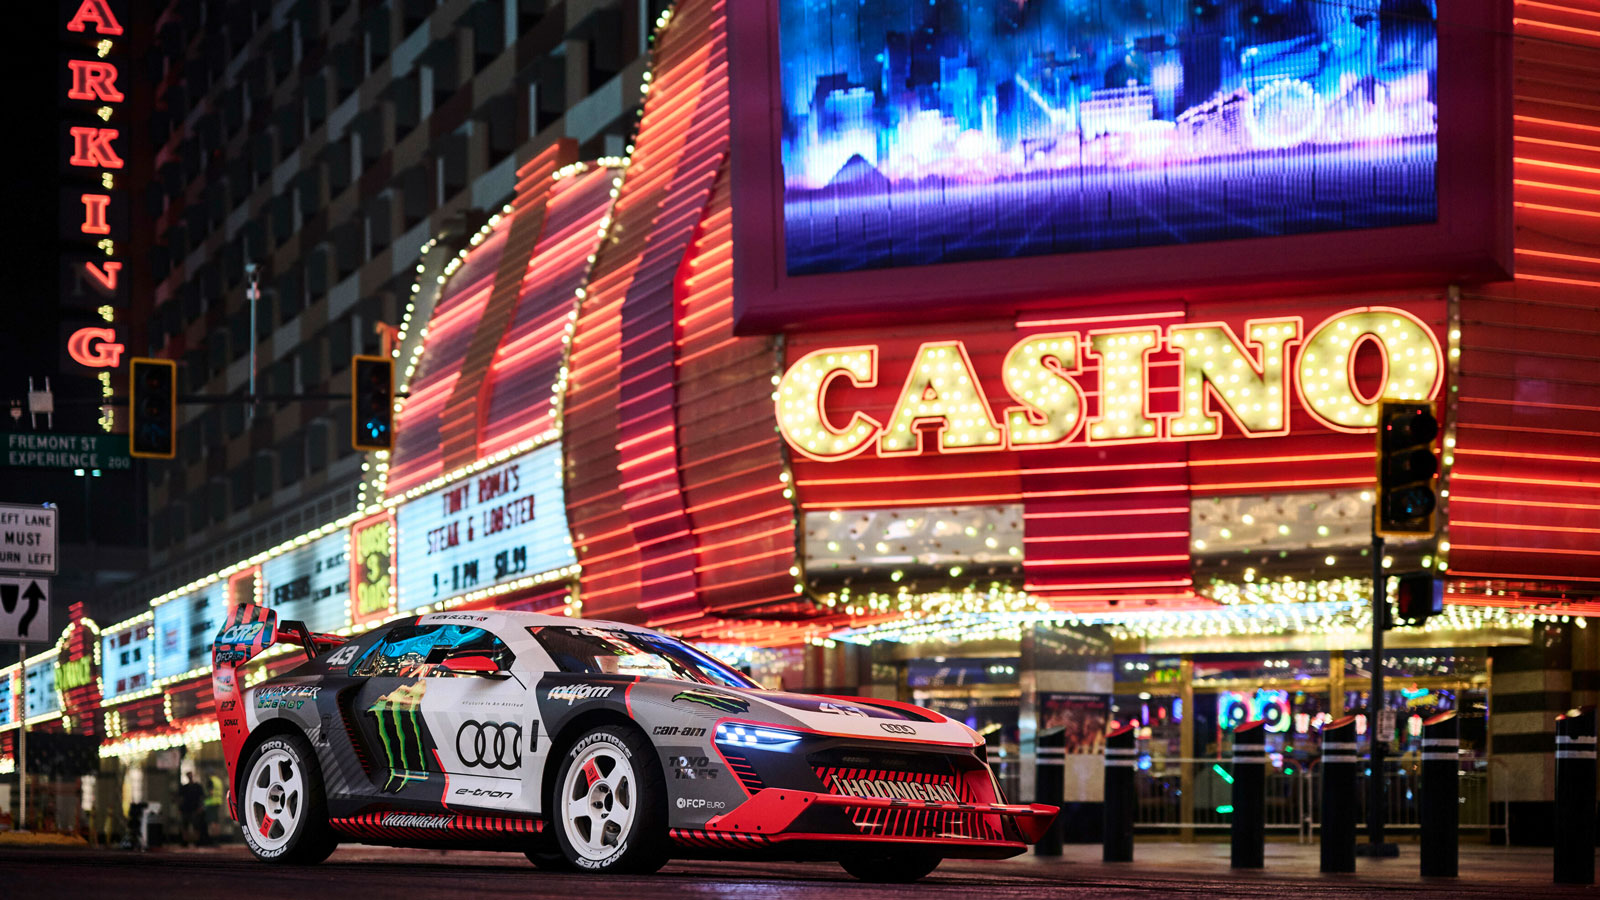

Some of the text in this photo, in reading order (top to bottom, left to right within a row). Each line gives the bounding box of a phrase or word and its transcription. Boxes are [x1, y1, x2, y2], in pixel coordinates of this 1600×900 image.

[775, 306, 1444, 462] CASINO
[9, 435, 97, 450] FREMONT ST
[9, 451, 130, 468] EXPERIENCE 200
[25, 515, 52, 528] LANE
[5, 532, 42, 546] MUST
[28, 553, 52, 565] LEFT
[326, 645, 360, 666] 43
[257, 699, 304, 710] ENERGY
[652, 726, 707, 736] can-am
[669, 756, 709, 767] TOYO
[455, 788, 513, 799] e-tron
[686, 799, 725, 809] FCP EURO
